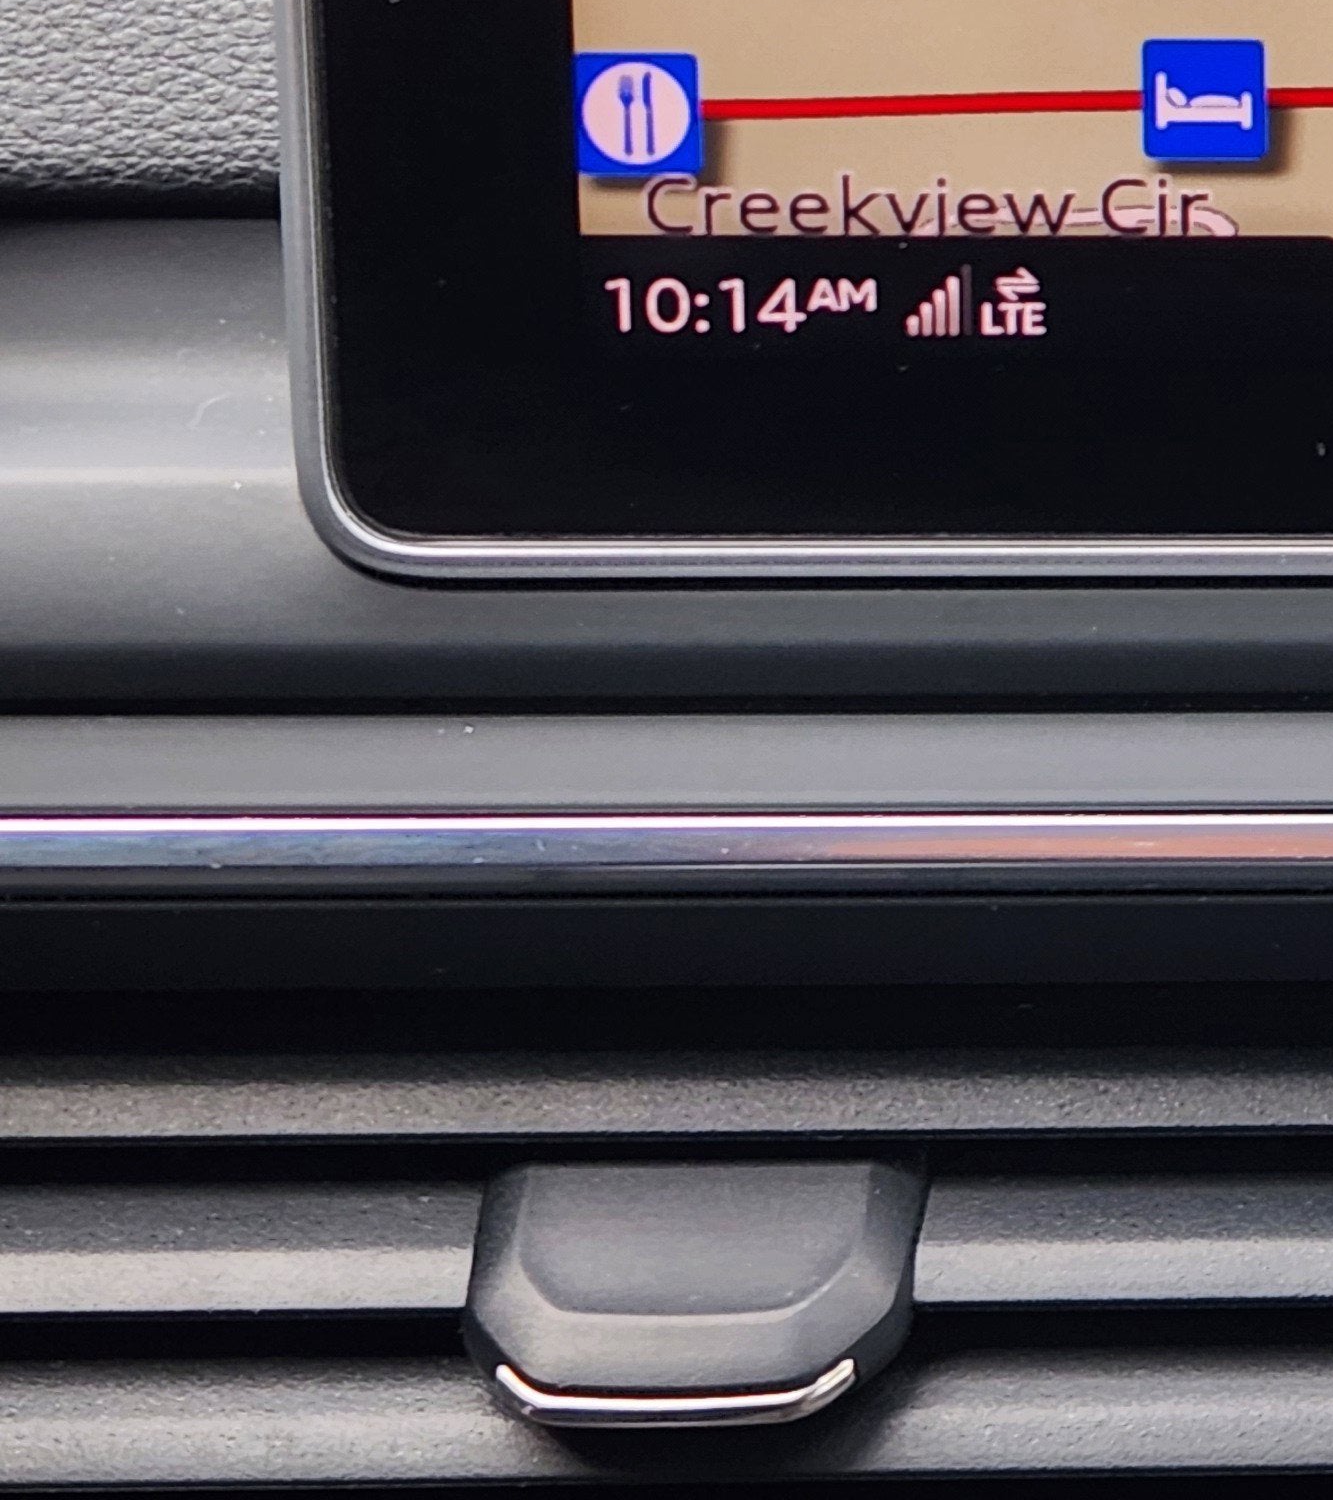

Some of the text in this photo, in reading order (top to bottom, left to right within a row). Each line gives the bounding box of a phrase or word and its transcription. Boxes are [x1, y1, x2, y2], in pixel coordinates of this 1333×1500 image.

[646, 174, 1211, 237] Creekview Cir
[979, 302, 1048, 337] LTE
